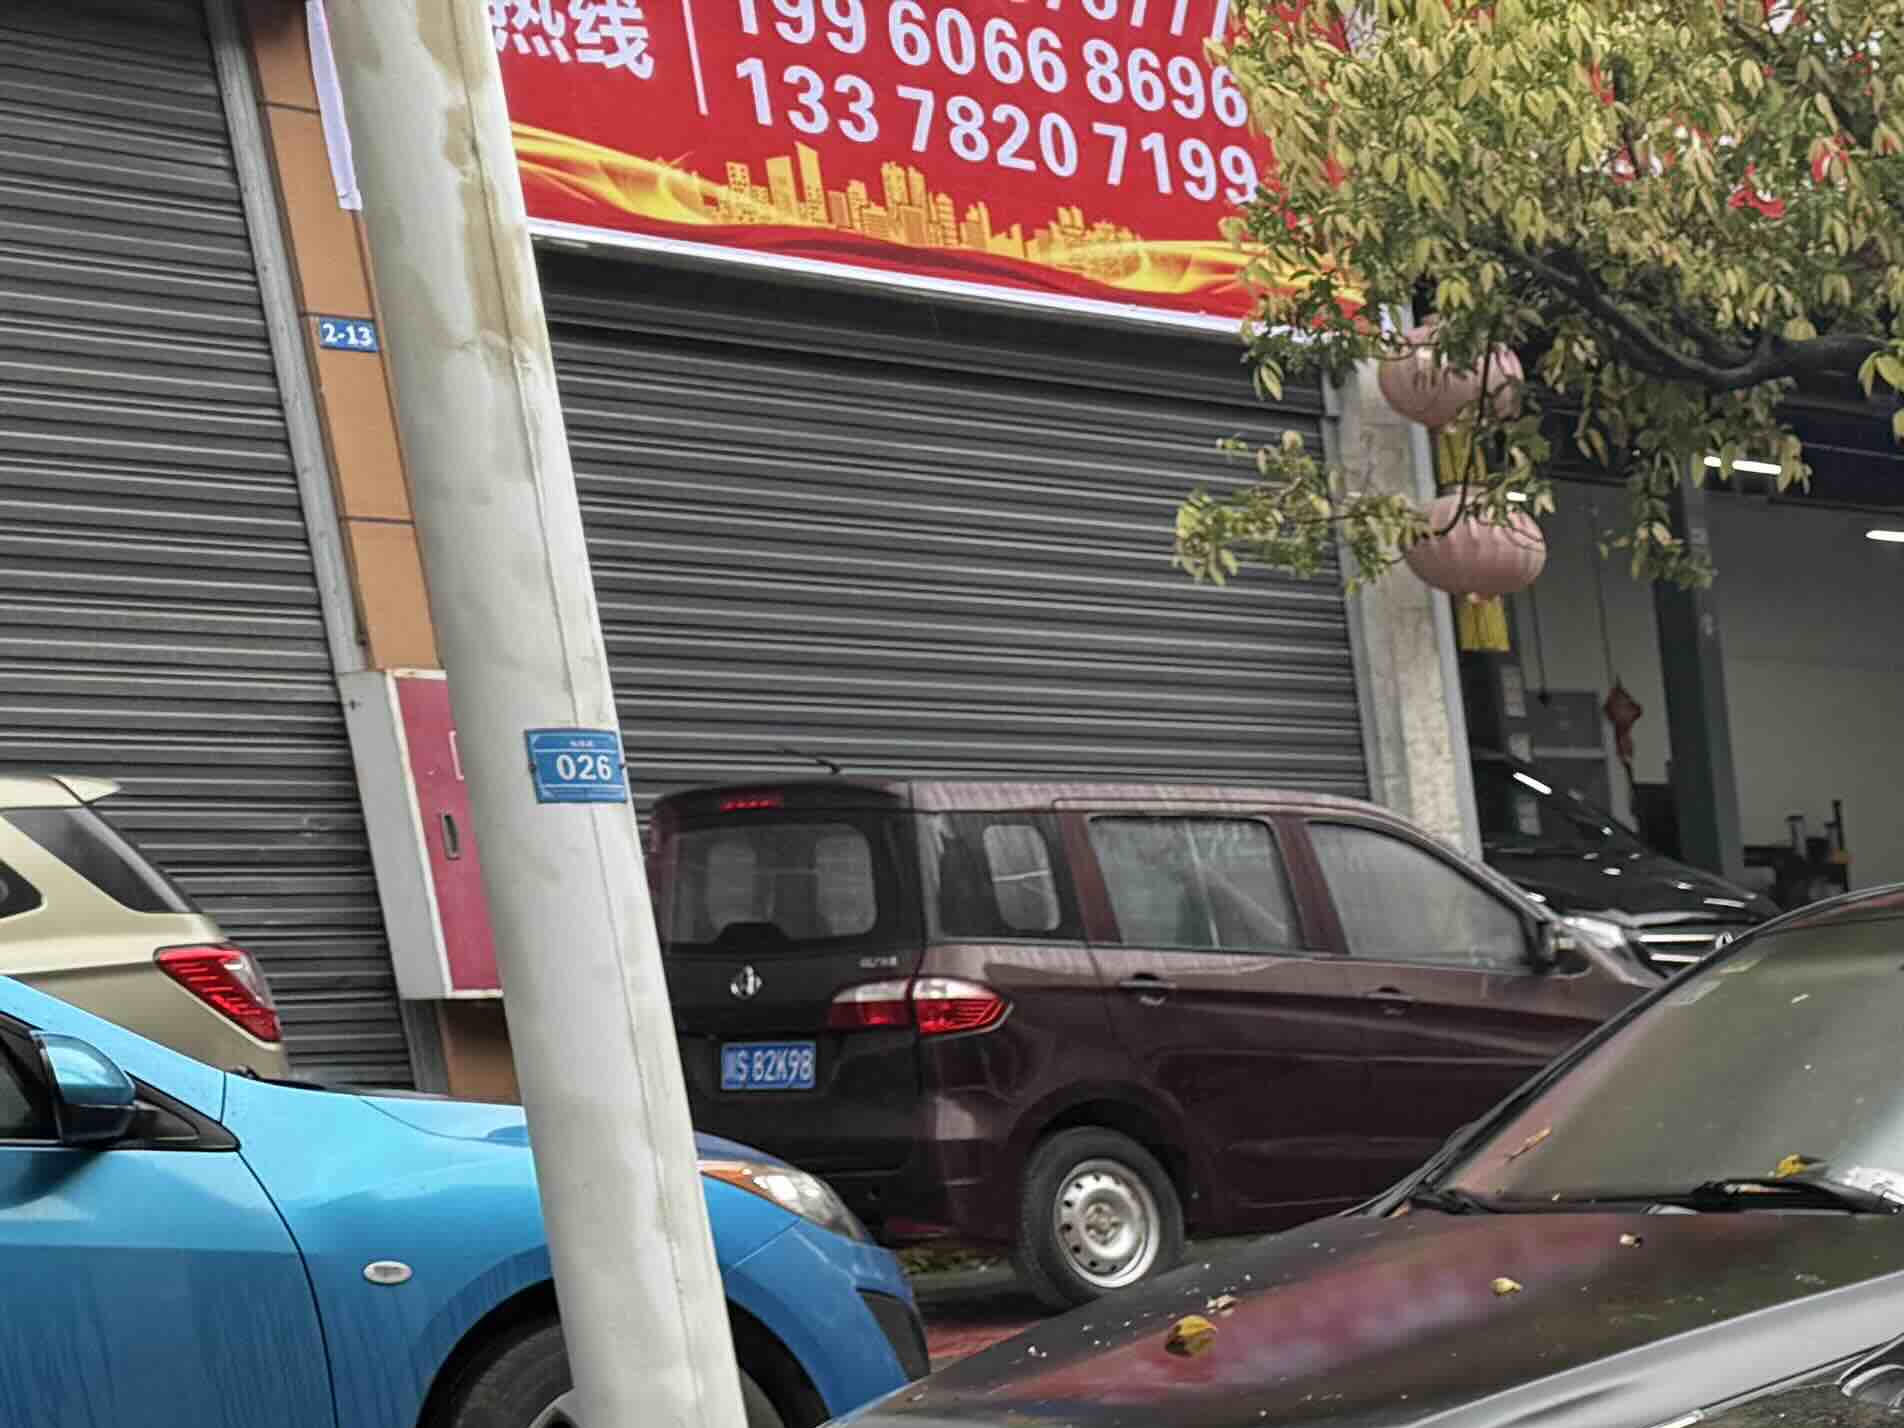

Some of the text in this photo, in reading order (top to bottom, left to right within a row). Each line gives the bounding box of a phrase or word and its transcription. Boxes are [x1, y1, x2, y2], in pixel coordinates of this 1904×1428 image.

[738, 0, 867, 53] 199
[888, 0, 1068, 94] 6066
[1082, 37, 1248, 128] 8696
[736, 57, 1259, 204] 133 7820 7199
[322, 323, 374, 346] 2-13
[555, 753, 612, 781] 026
